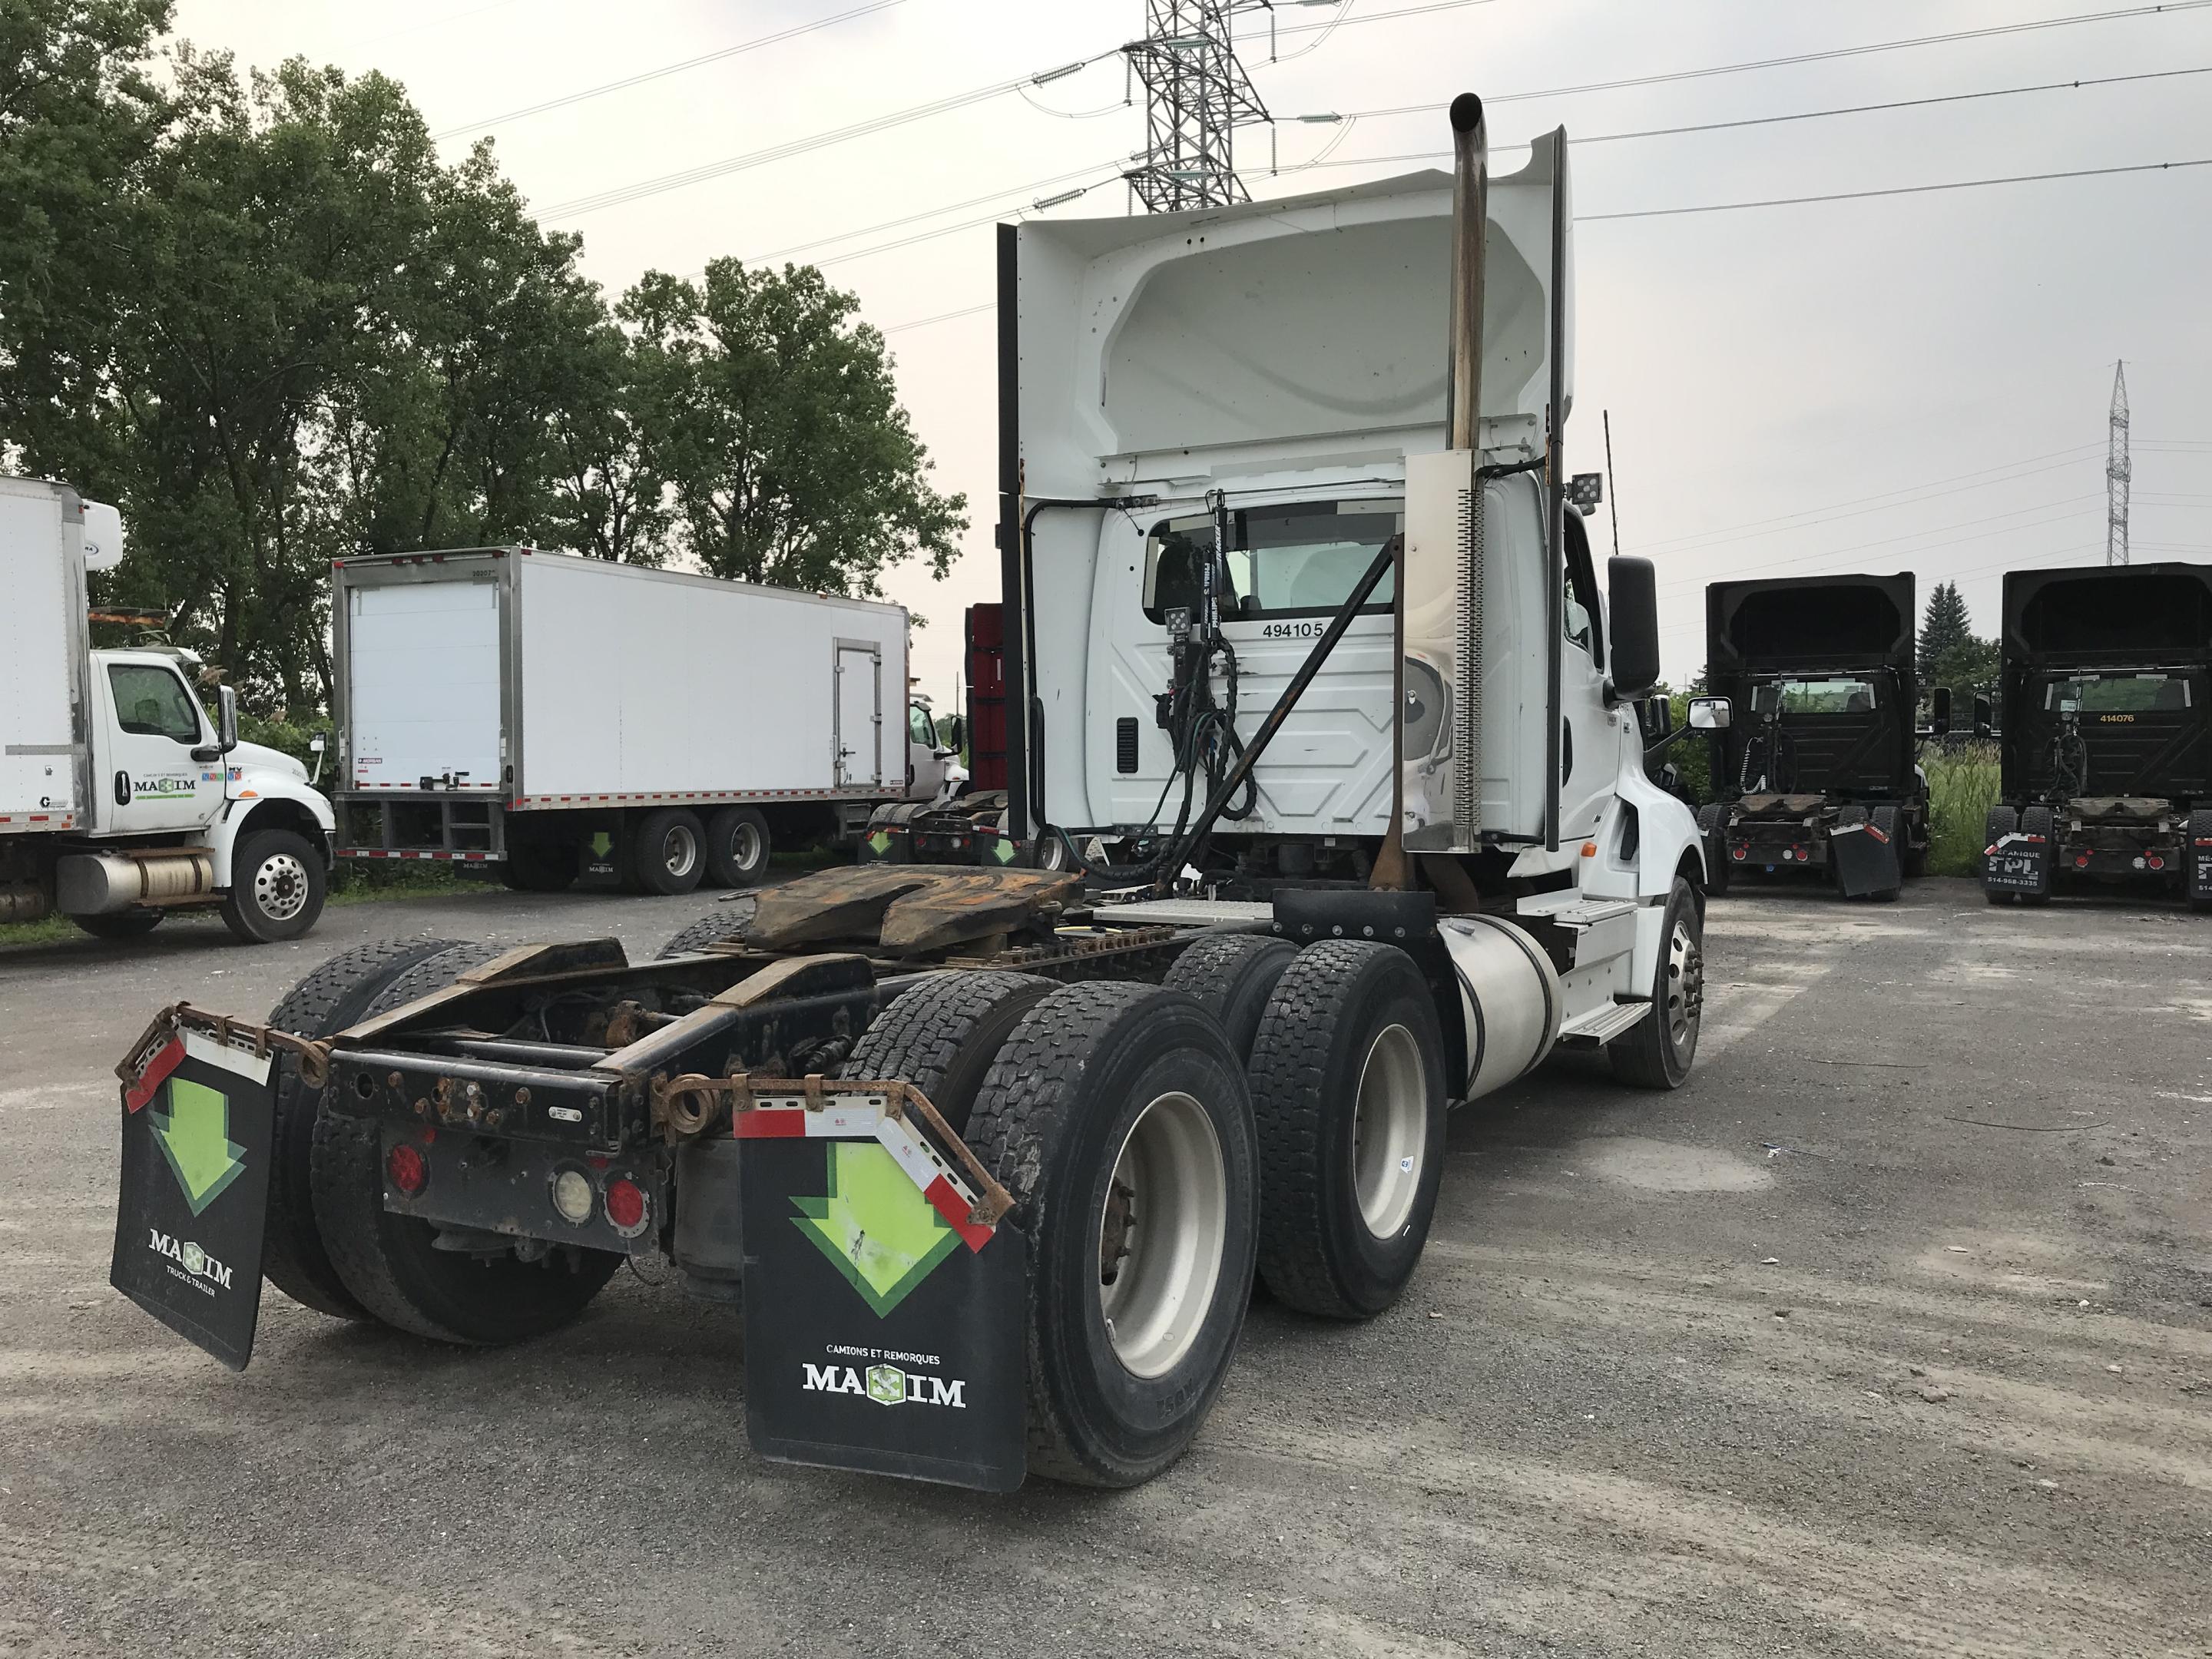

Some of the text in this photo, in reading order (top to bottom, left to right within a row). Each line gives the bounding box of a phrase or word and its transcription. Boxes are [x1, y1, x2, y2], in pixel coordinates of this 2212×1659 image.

[1263, 623, 1323, 637] 494105
[2100, 714, 2134, 723] 414076
[134, 777, 196, 793] MAXIM
[148, 1228, 233, 1290] MAXIM
[166, 1265, 215, 1298] TRUCK & TRAILER
[826, 1344, 940, 1365] CAMIONS ET REMORQUES
[802, 1363, 966, 1409] MAXIM
